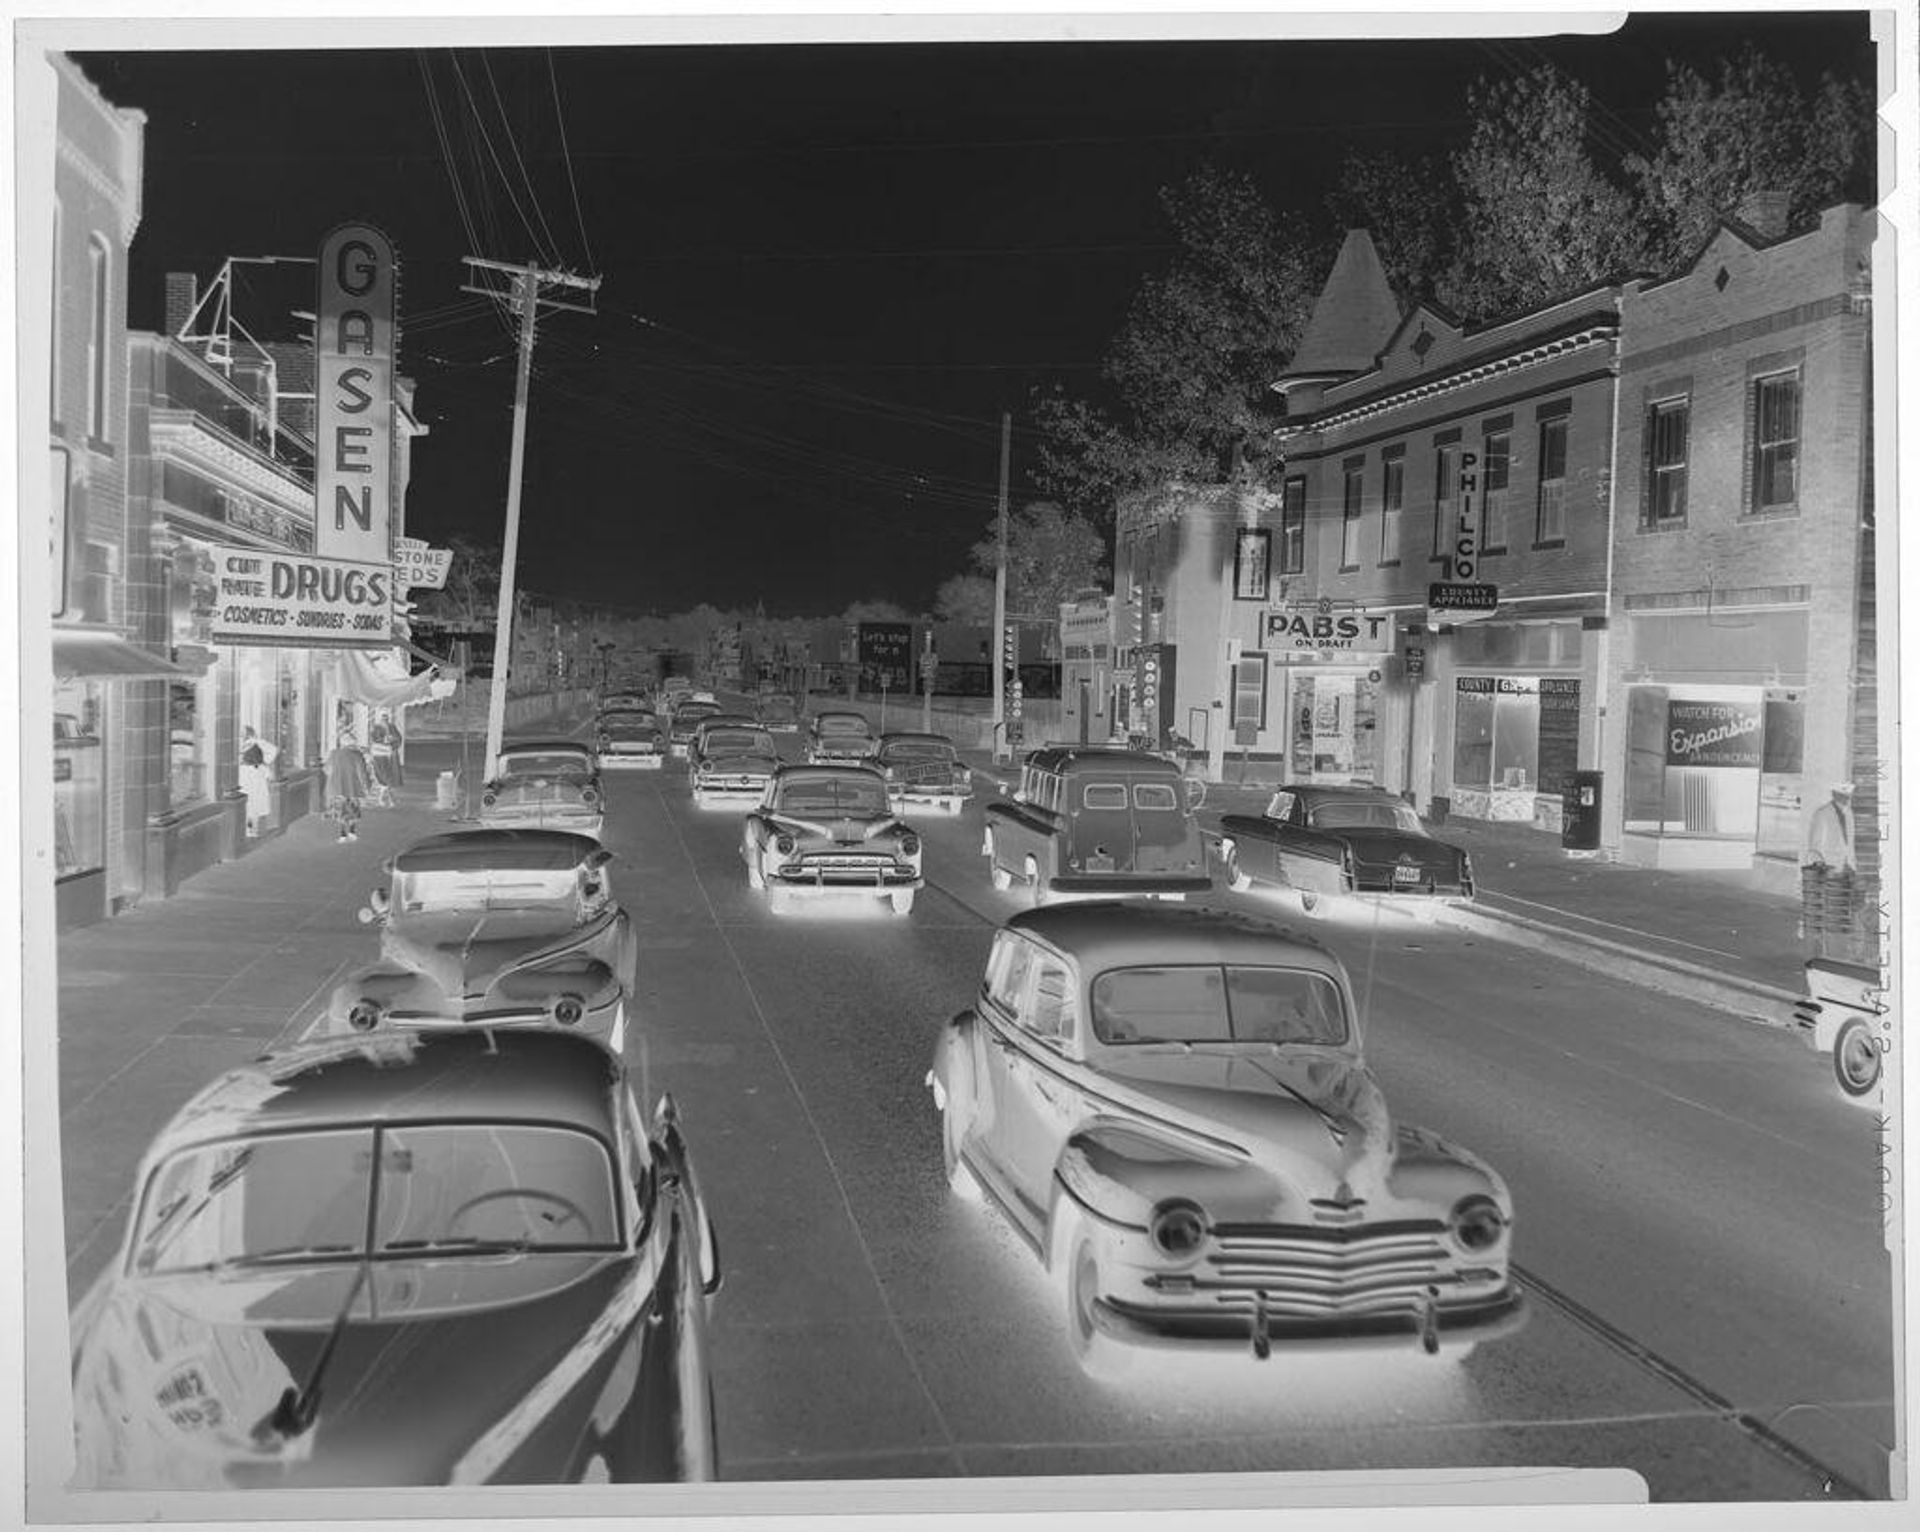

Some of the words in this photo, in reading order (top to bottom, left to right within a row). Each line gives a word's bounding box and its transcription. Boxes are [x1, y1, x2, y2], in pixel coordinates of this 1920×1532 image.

[336, 240, 376, 531] GASEN
[1457, 453, 1477, 578] PHILCO
[271, 561, 388, 606] DRUGS
[223, 605, 289, 626] COSMETICS
[297, 610, 346, 630] SUNDRIES
[352, 614, 384, 631] SODAS
[1268, 615, 1387, 639] PABST
[1296, 639, 1312, 647] ON
[1318, 639, 1352, 648] DRAFT
